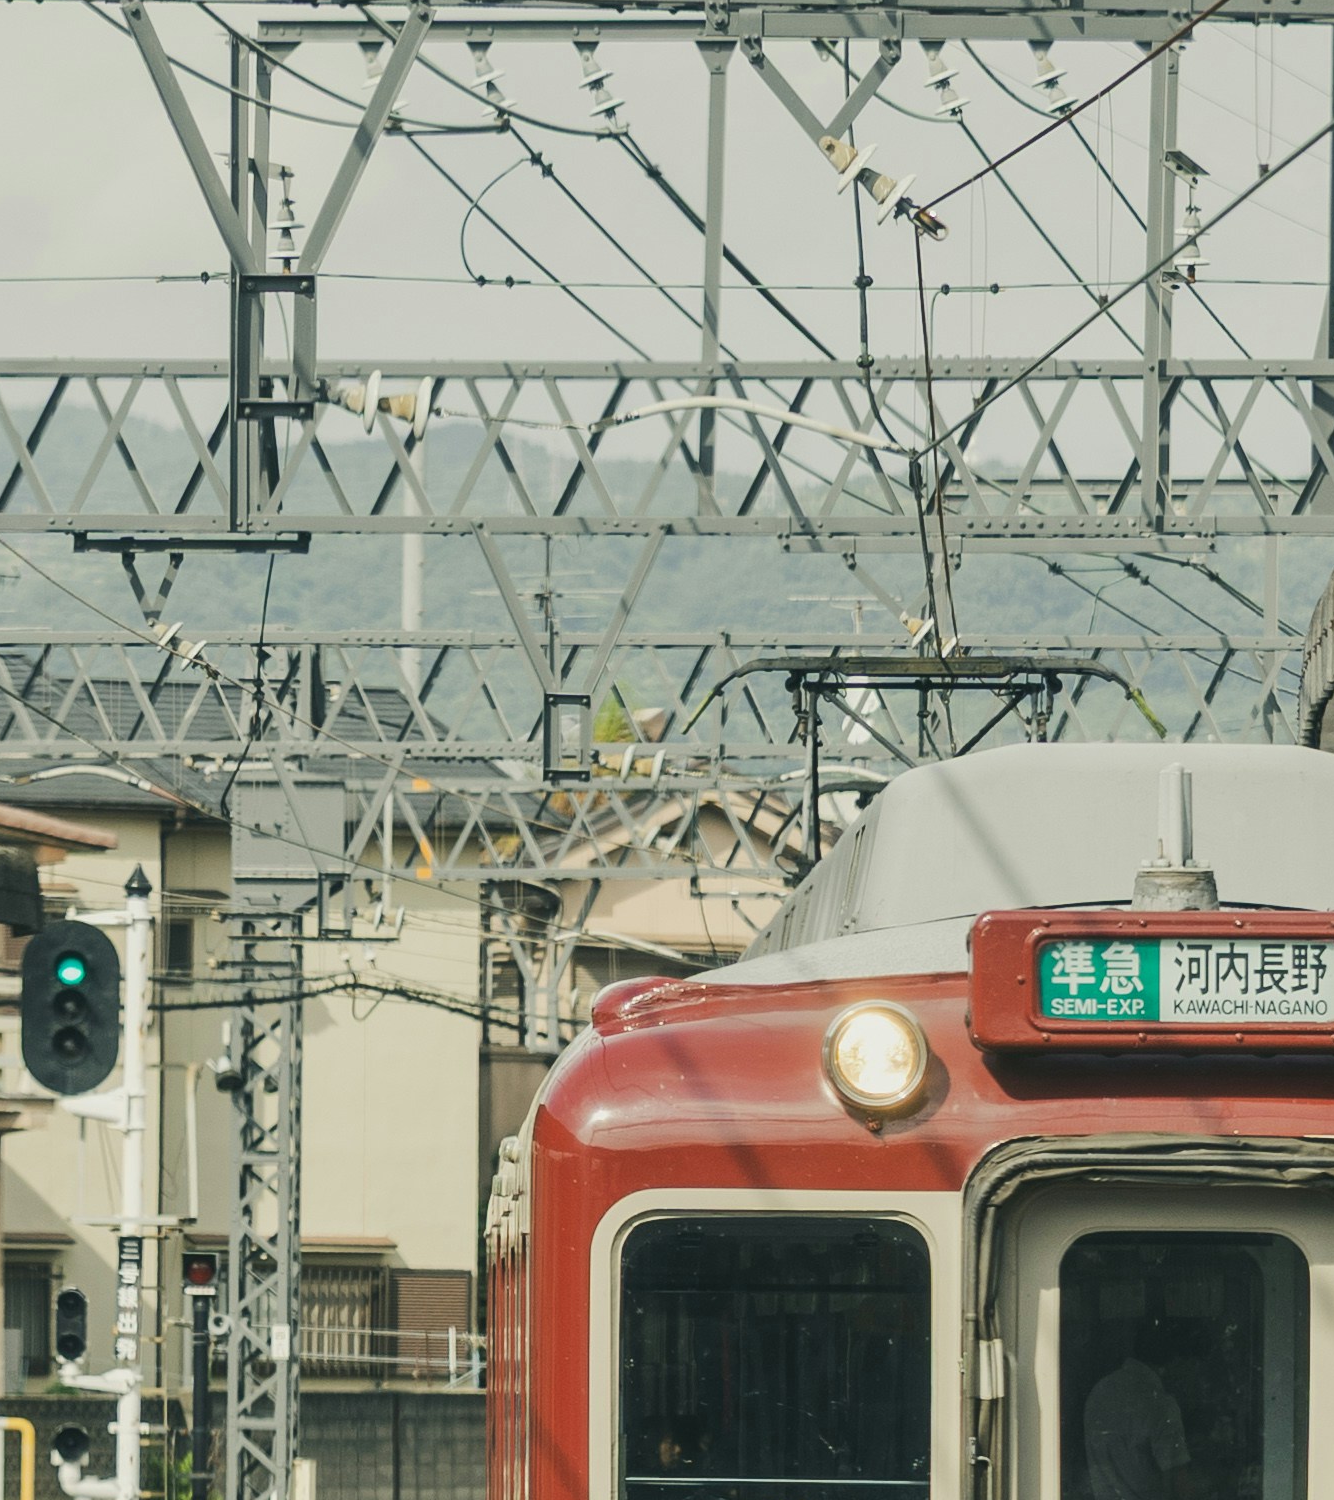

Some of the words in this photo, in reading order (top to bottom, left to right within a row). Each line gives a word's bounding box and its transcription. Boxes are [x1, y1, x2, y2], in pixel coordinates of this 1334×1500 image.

[1051, 941, 1145, 995] 準急
[1174, 941, 1327, 995] 河内長野
[1051, 998, 1145, 1015] SEMI-EXP.
[1173, 999, 1328, 1016] KAWACHI-NAGANO
